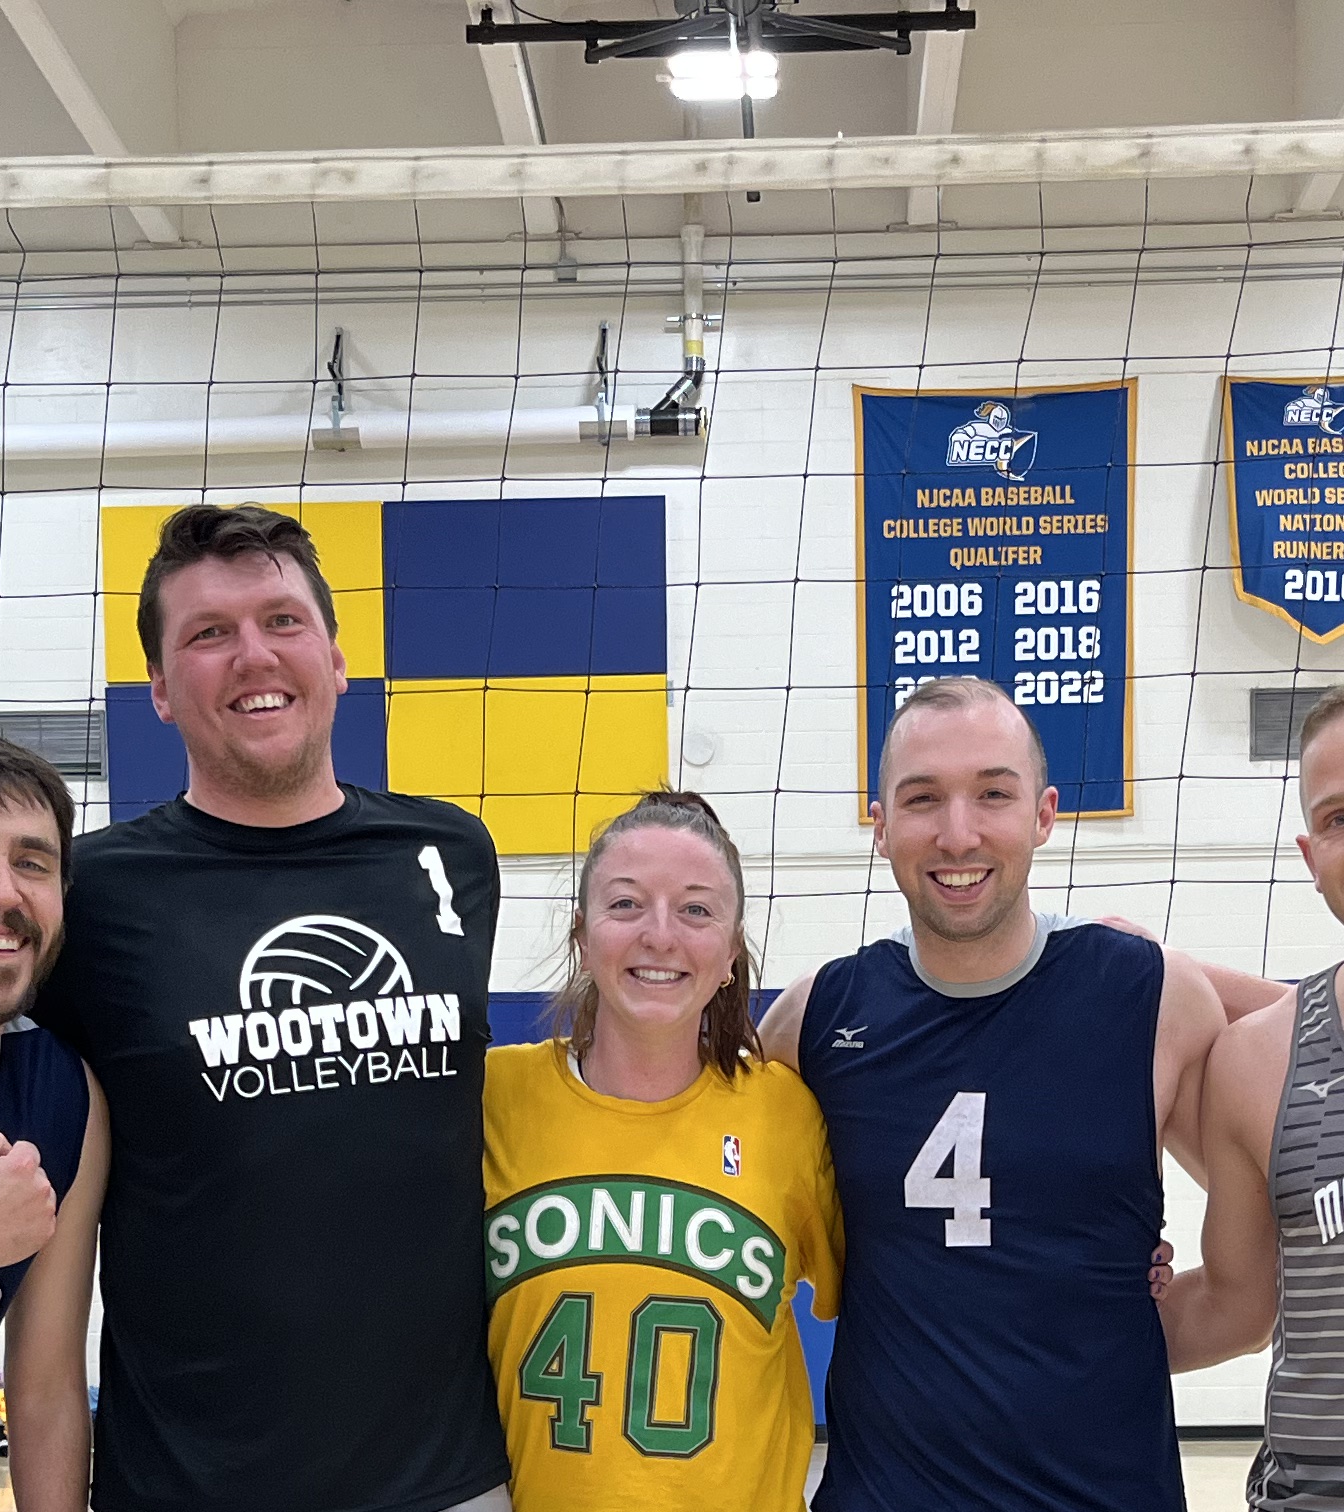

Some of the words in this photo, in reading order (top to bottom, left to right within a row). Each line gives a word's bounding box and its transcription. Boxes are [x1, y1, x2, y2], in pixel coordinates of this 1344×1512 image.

[1287, 407, 1334, 423] NECC
[950, 438, 1014, 462] NECC
[1246, 438, 1304, 456] NJCAA
[917, 488, 976, 508] NJCAA
[981, 485, 1074, 506] BASEBALL
[1255, 488, 1320, 506] WORLD
[883, 518, 963, 538] COLLEGE
[967, 516, 1034, 537] WORLD
[1039, 514, 1108, 535] SERIES
[950, 546, 1042, 570] QUALIFER
[891, 582, 983, 618] 2006
[1014, 579, 1101, 615] 2016
[894, 629, 980, 664] 2012
[1014, 625, 1101, 661] 2018
[1014, 670, 1104, 706] 2022
[418, 845, 464, 936] 1
[189, 993, 461, 1067] WOOTOWN
[201, 1046, 457, 1101] VOLLEYBALL
[904, 1091, 991, 1247] 4
[488, 1188, 774, 1299] SONICS
[518, 1292, 725, 1460] 40
